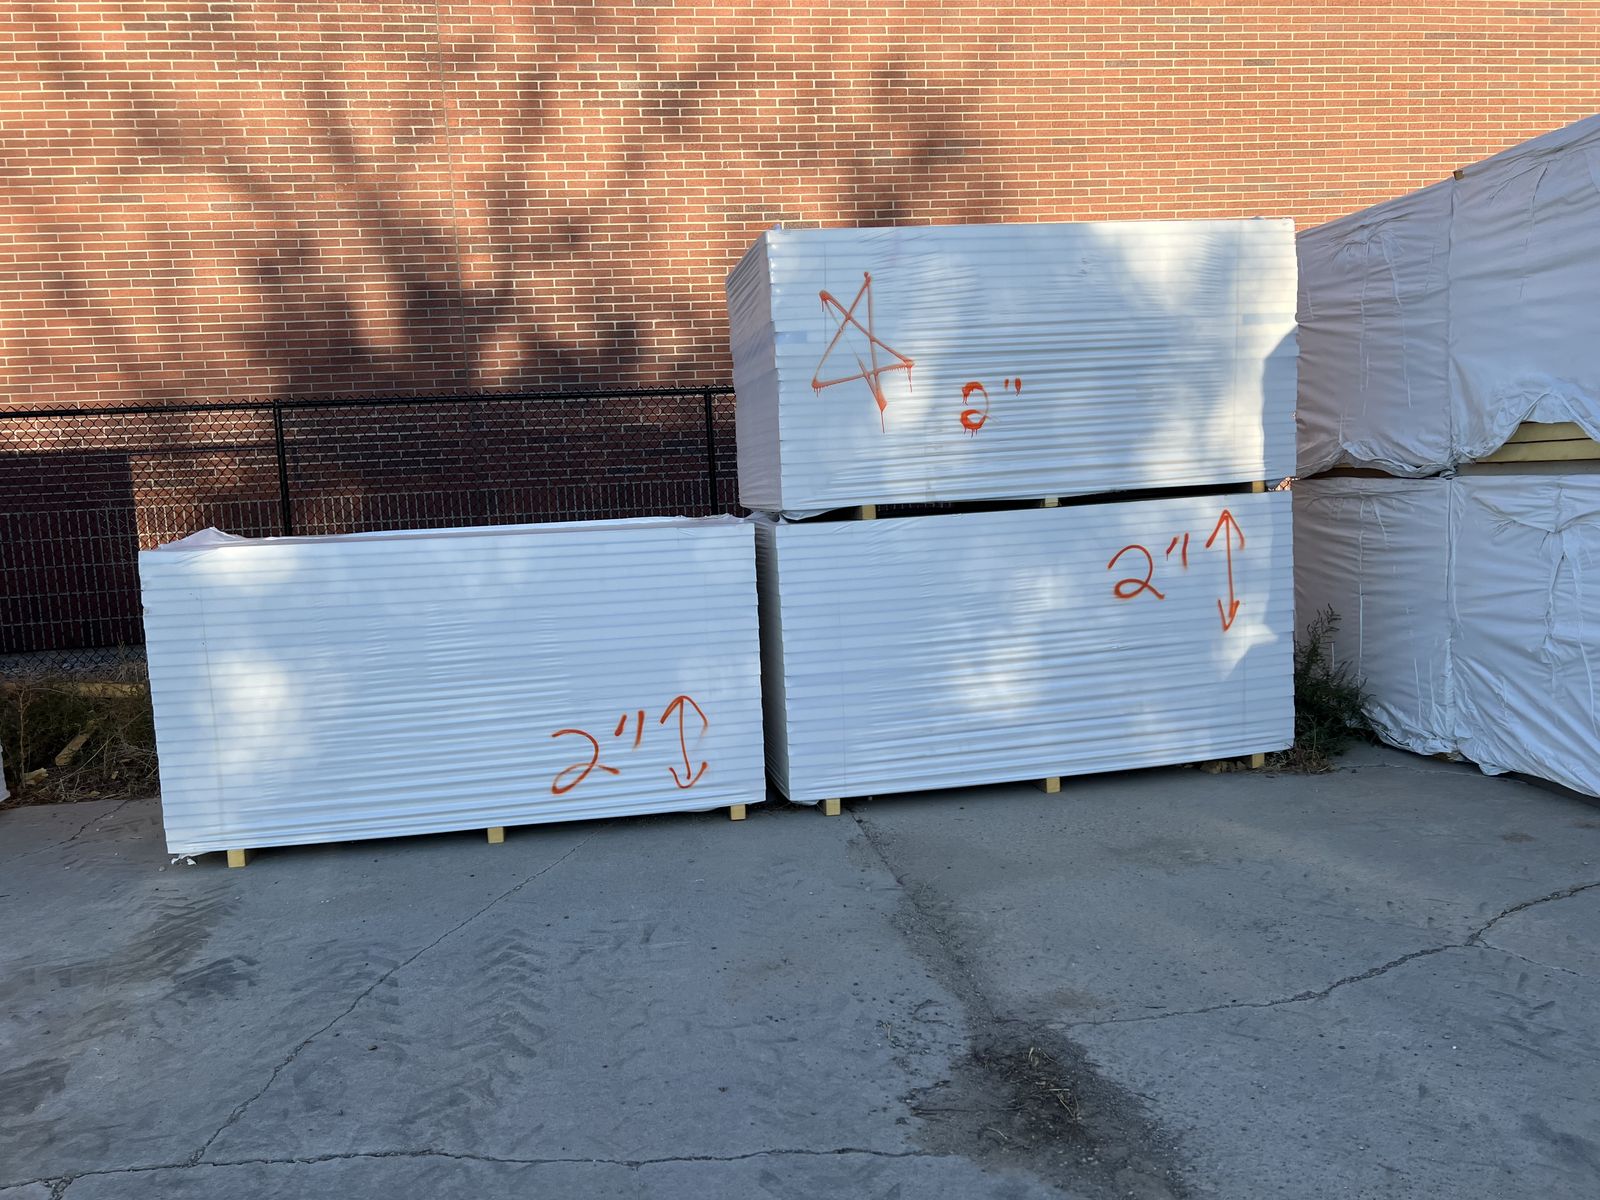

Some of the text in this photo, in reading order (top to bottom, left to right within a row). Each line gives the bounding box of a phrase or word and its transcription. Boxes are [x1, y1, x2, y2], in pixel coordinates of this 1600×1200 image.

[960, 378, 1022, 434] 2"
[1107, 532, 1189, 600] 2"
[551, 710, 645, 795] 2"
